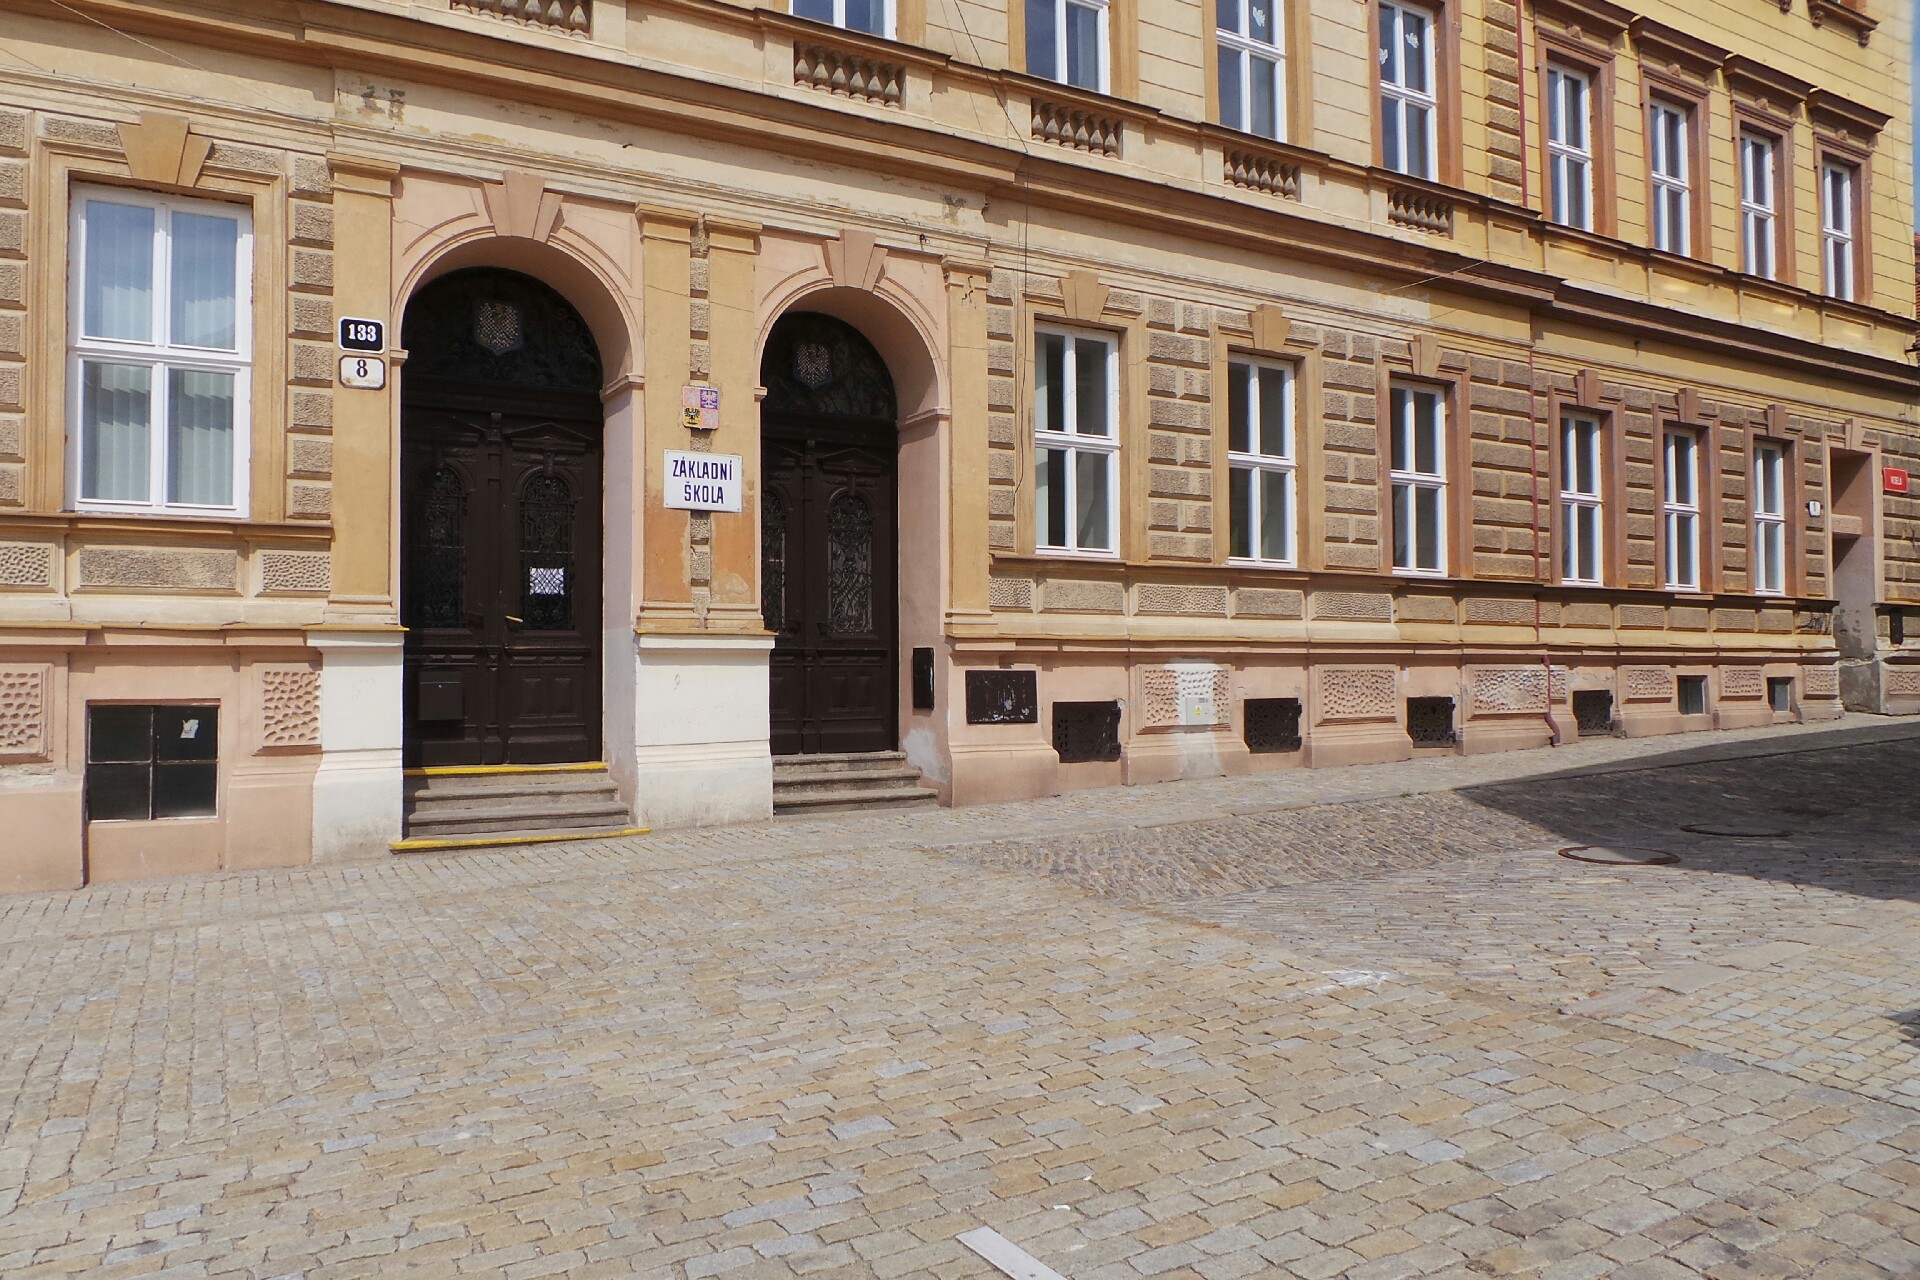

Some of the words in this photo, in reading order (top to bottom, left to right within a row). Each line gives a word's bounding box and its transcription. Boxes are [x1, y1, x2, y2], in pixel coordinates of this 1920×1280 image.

[348, 323, 377, 342] 133
[356, 359, 368, 378] 8
[672, 456, 734, 481] ZÁKLADNÍ
[684, 481, 724, 504] ŠKOLA
